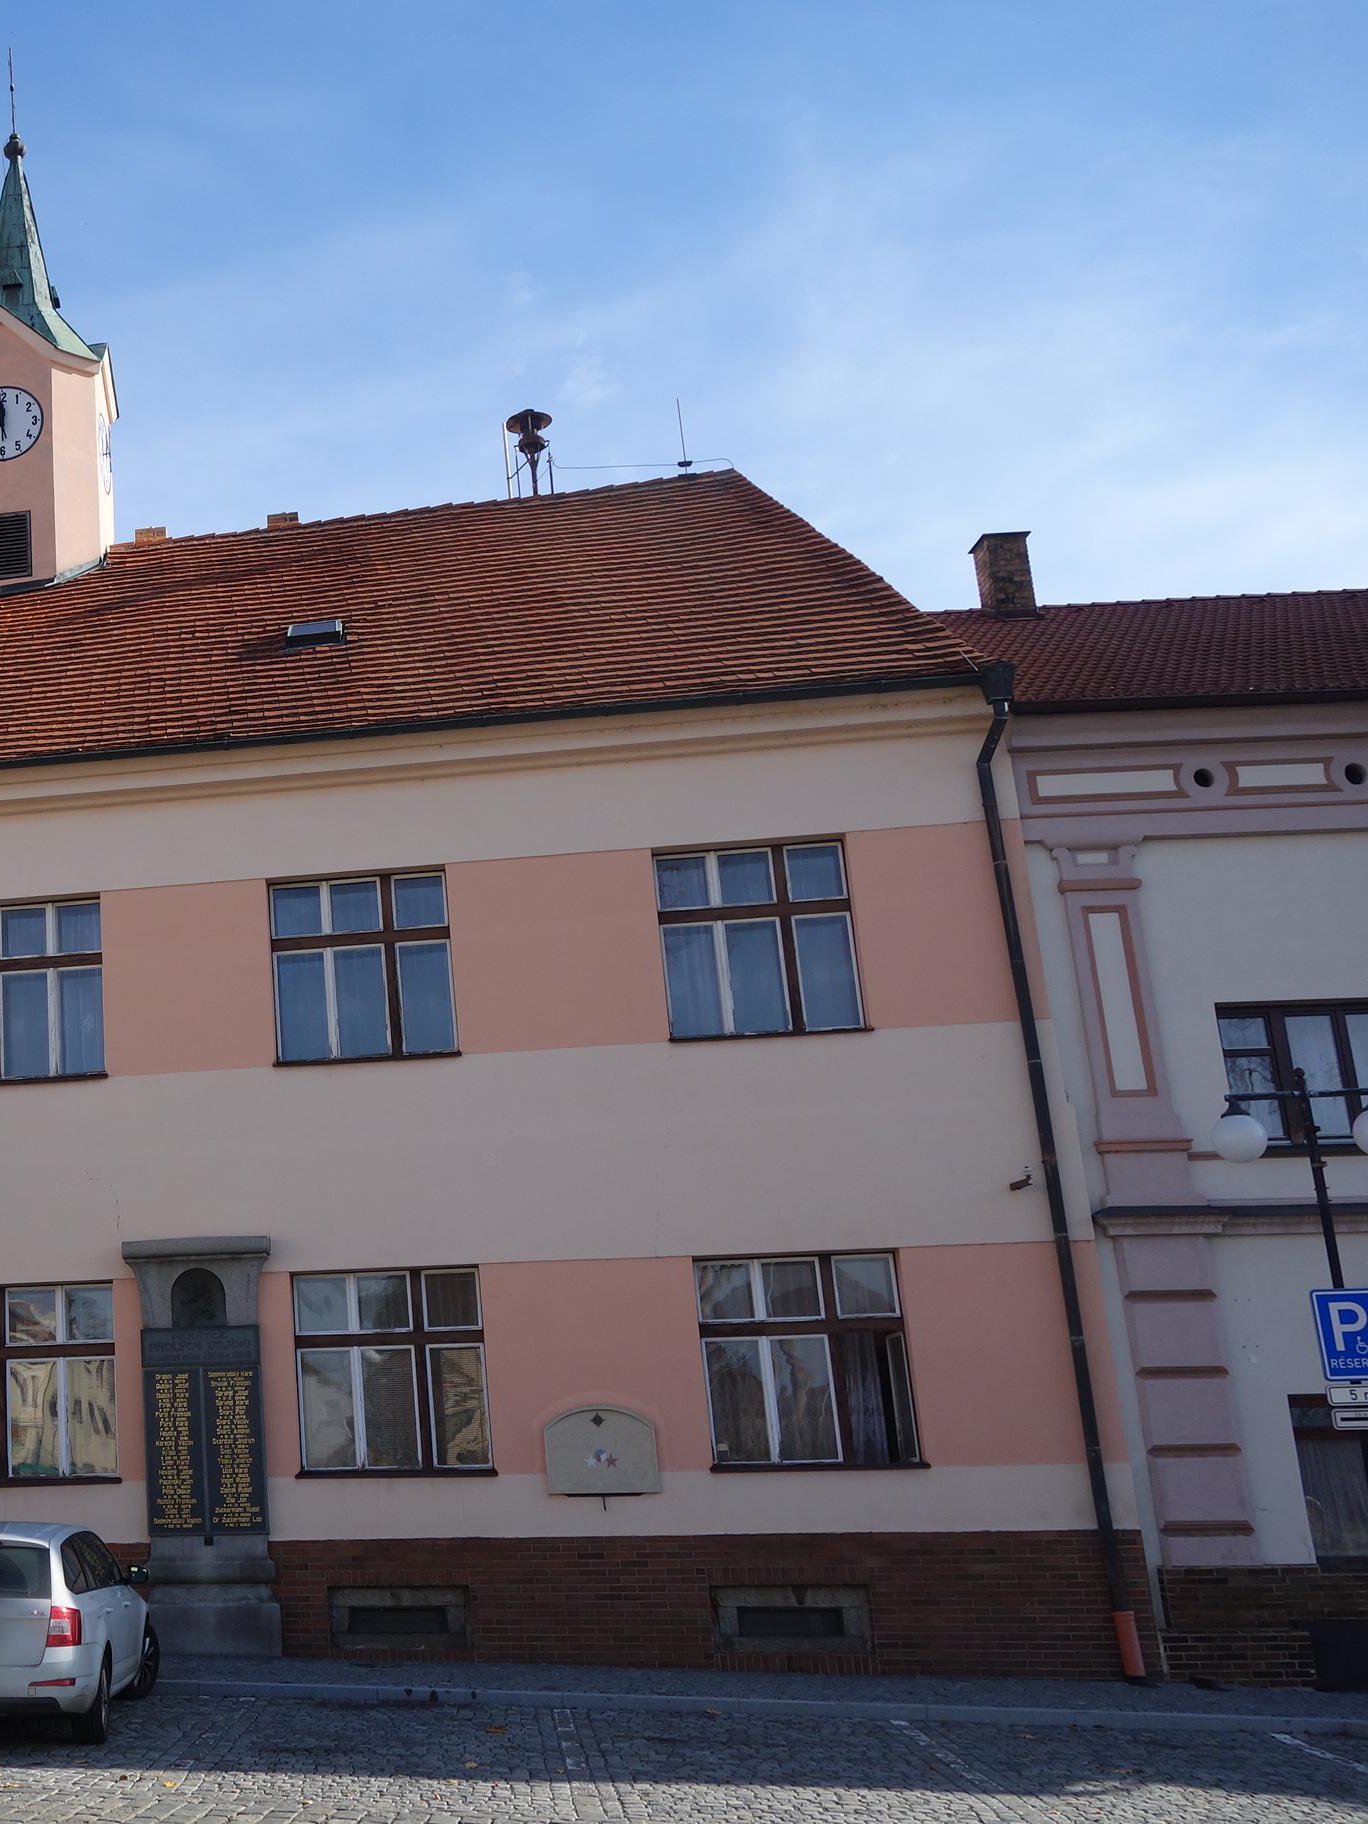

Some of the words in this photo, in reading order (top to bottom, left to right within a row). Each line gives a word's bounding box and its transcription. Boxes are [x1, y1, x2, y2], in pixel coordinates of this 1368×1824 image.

[15, 394, 19, 404] 1
[25, 402, 32, 412] 2
[31, 415, 37, 425] 3
[26, 429, 32, 439] 4
[0, 446, 6, 456] 6
[15, 441, 21, 451] 5
[1328, 1302, 1368, 1351] P
[1349, 1390, 1357, 1400] 5
